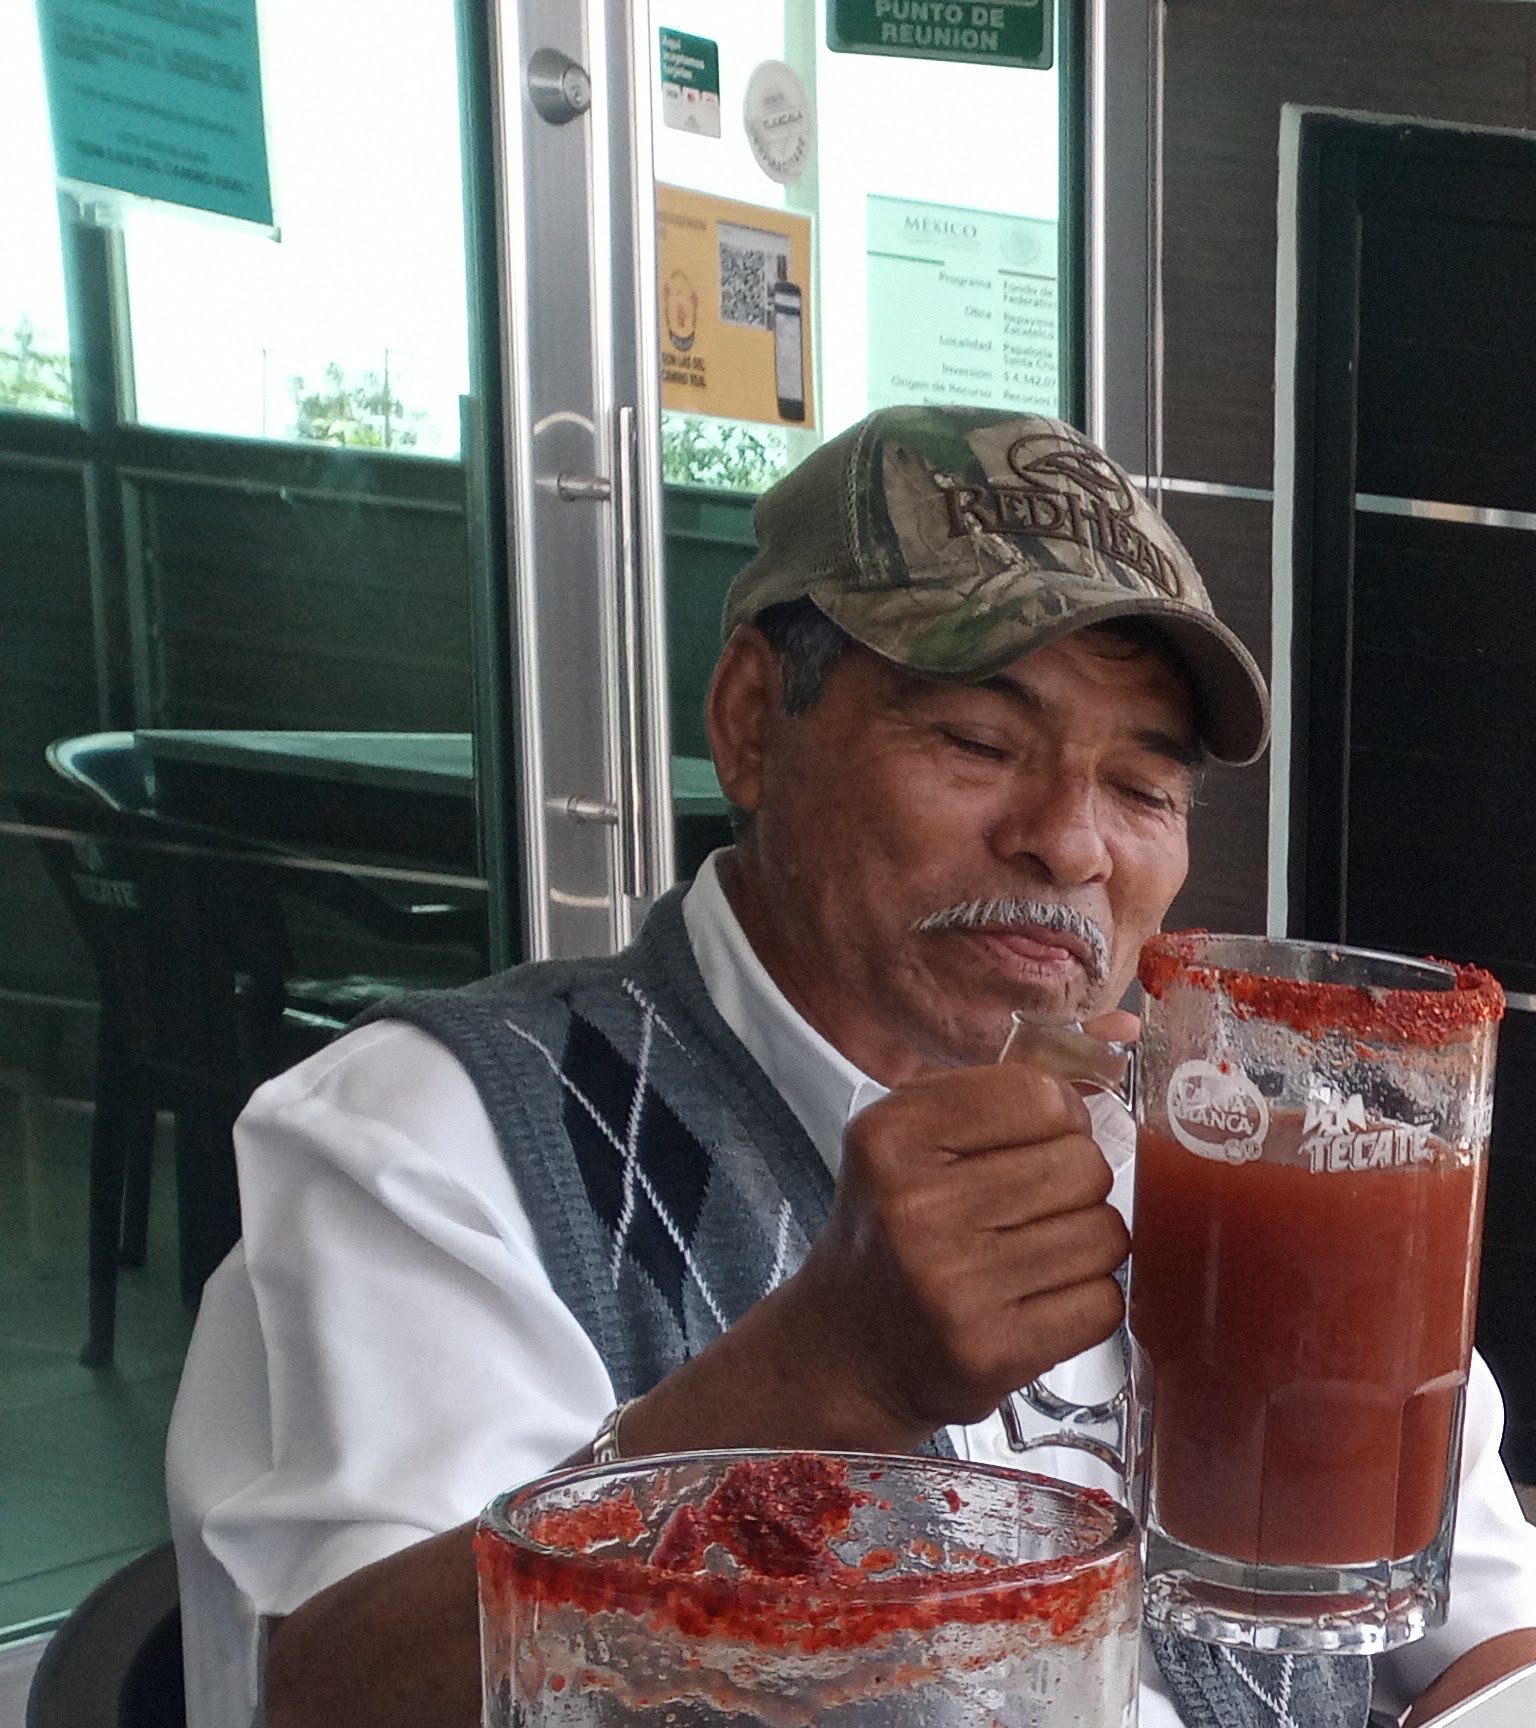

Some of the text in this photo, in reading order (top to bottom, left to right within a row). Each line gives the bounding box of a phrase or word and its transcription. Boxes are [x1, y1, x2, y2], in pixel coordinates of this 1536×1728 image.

[875, 1, 1005, 27] PUNTO DE
[881, 22, 999, 50] REUNION
[1300, 1124, 1434, 1175] TECATE
